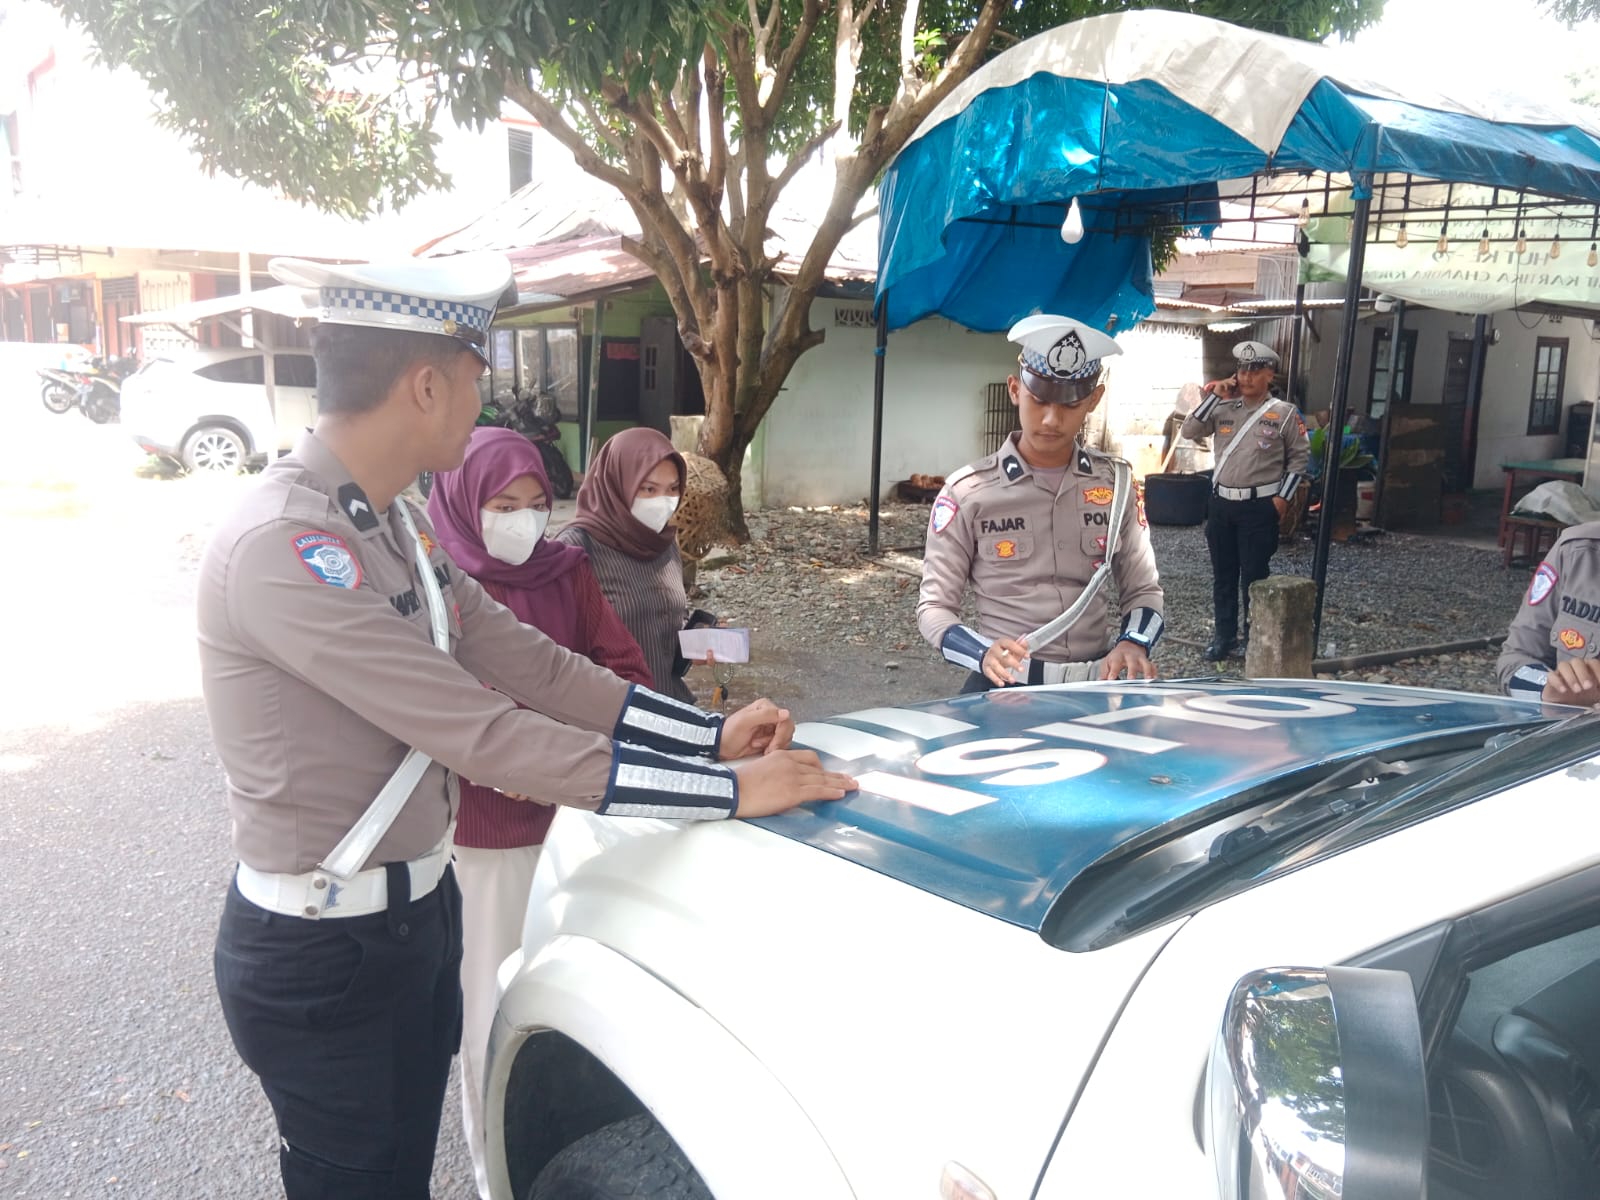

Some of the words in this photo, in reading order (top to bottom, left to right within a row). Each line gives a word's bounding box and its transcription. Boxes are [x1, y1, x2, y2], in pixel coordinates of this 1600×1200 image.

[981, 517, 1026, 534] FAJAR
[1083, 511, 1109, 526] POL
[852, 687, 1455, 816] POLISI
